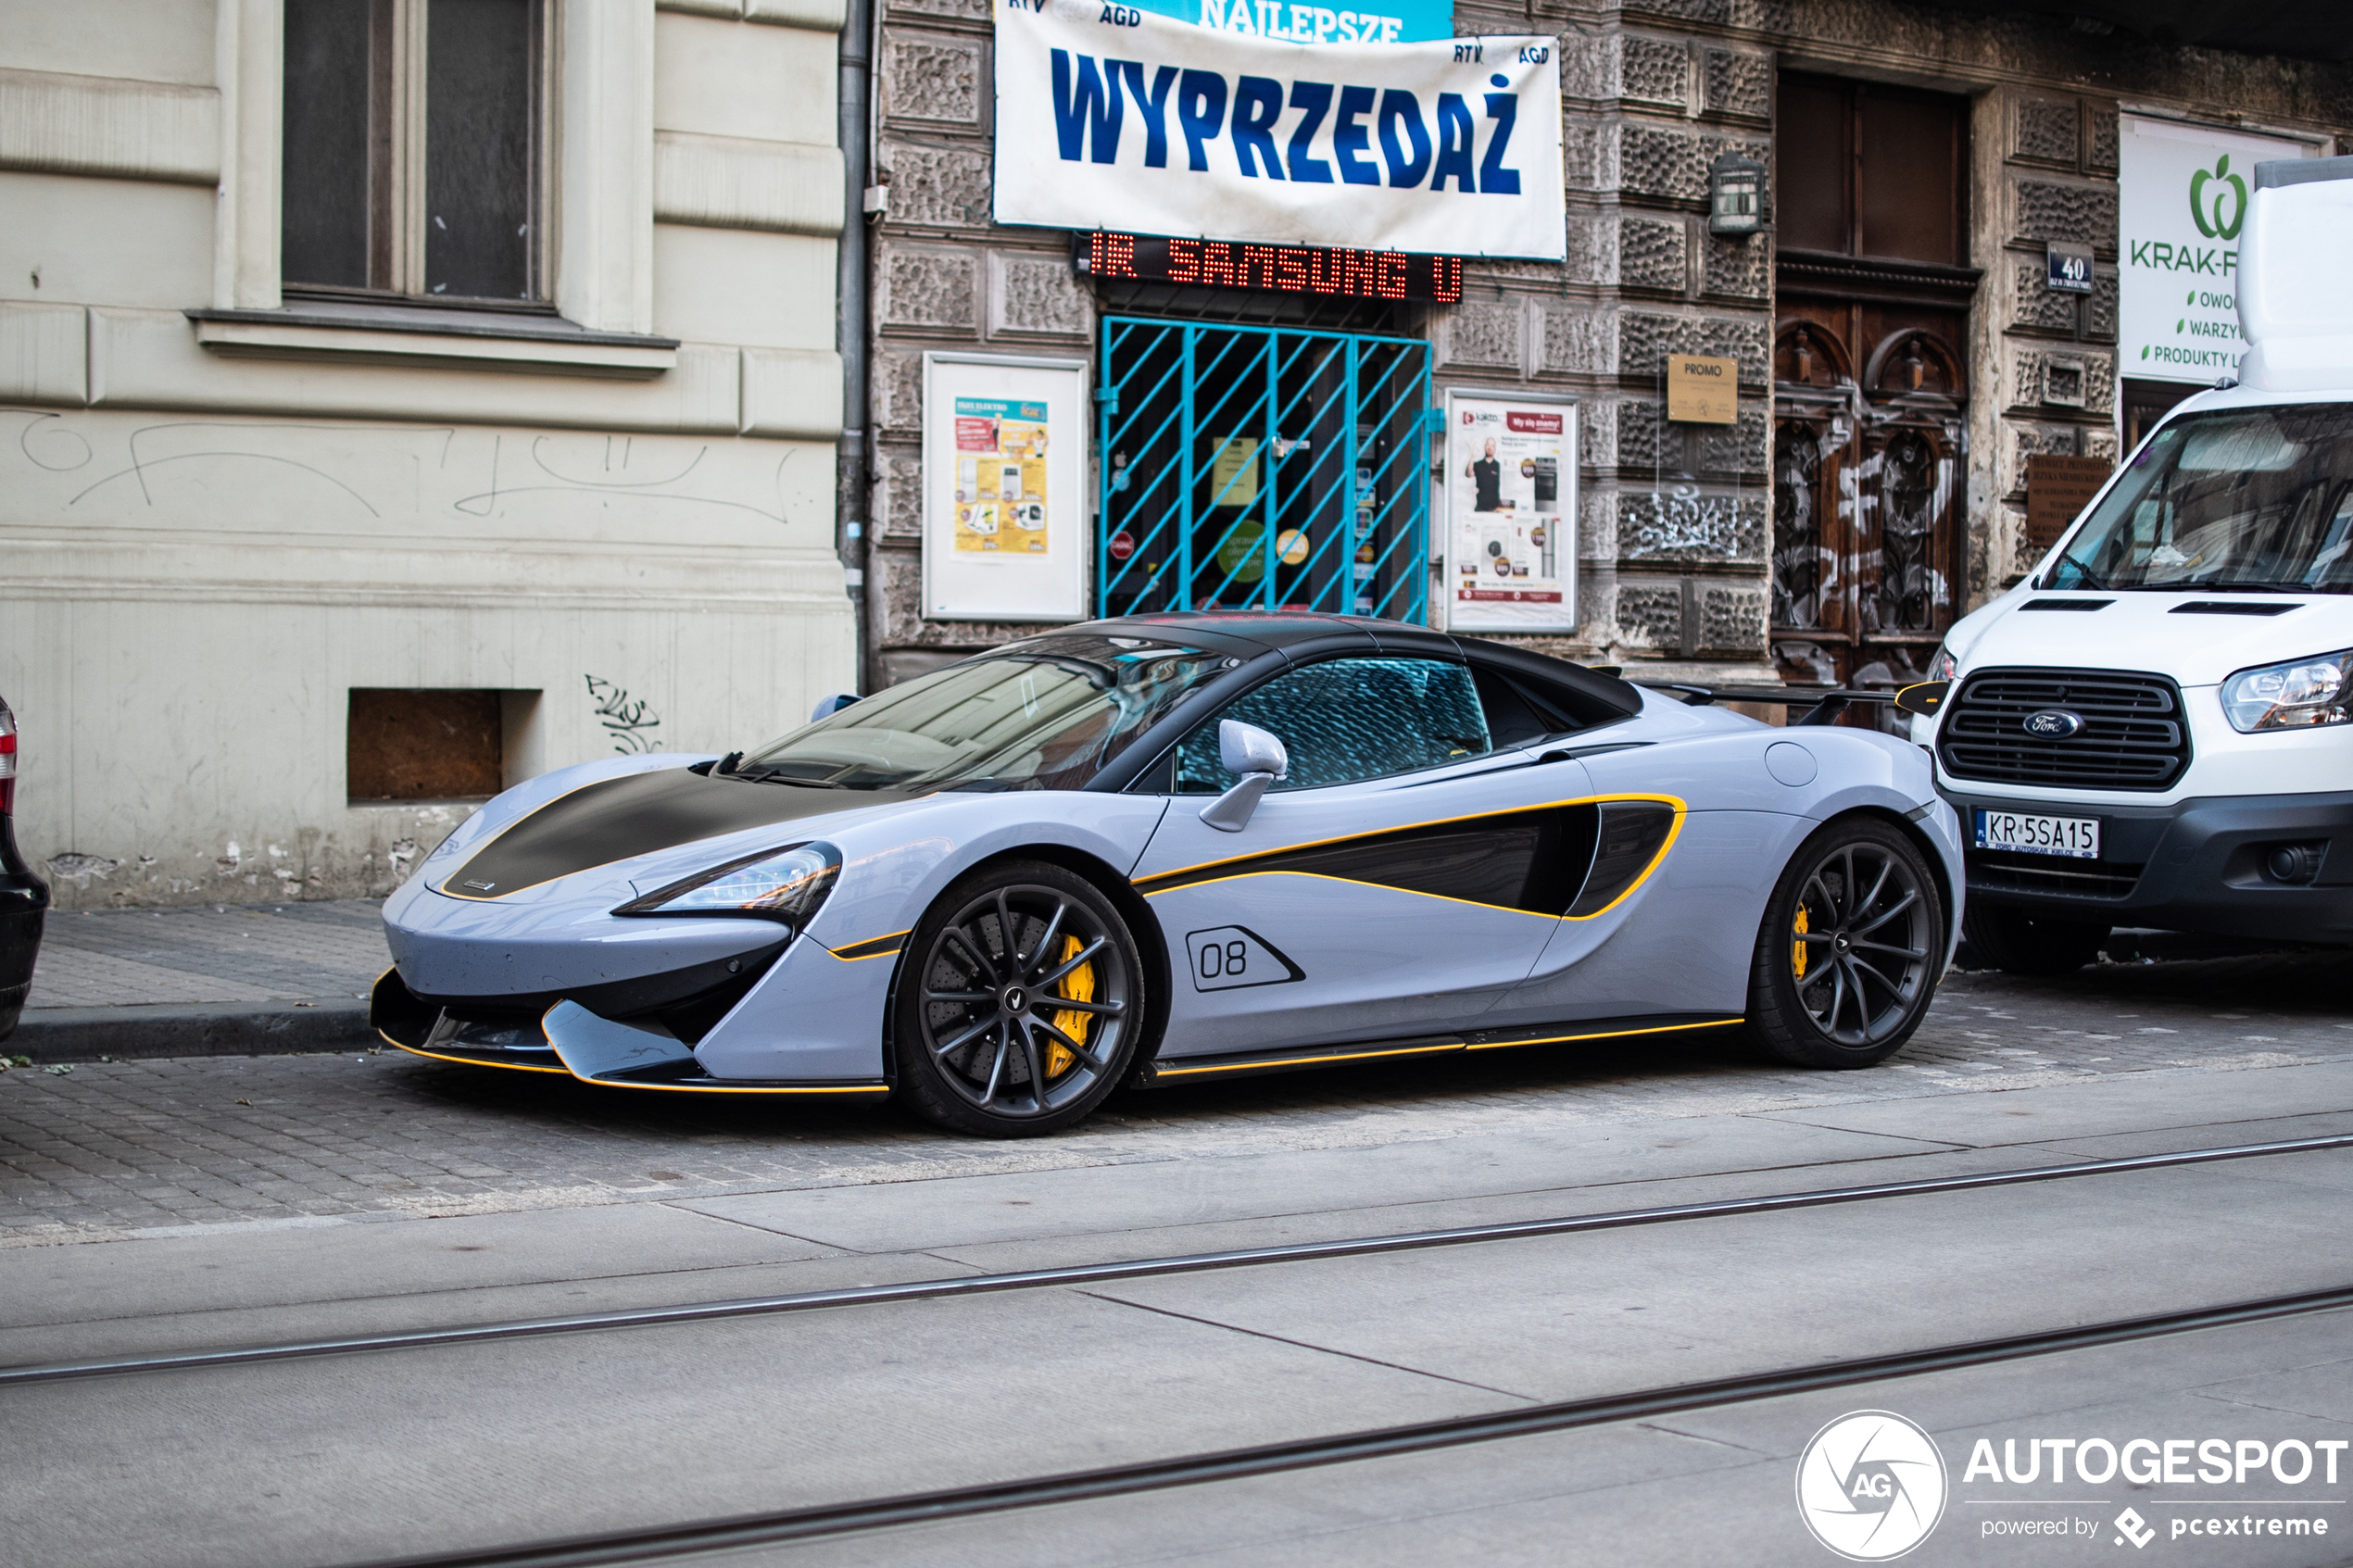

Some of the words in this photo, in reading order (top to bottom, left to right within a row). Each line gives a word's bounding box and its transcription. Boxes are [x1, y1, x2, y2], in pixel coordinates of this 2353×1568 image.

[1099, 5, 1140, 27] AGD
[1453, 44, 1483, 63] RTV
[1518, 46, 1549, 64] AGD
[1051, 47, 1521, 194] WYPRZEDAŻ
[1168, 238, 1407, 298] SAMSUNG
[2062, 257, 2084, 281] 40
[2155, 345, 2229, 368] PRODUKTY
[1684, 363, 1723, 377] PROMO
[2032, 715, 2063, 733] Ford
[1989, 814, 2017, 844] KR
[2025, 817, 2094, 849] 5SA15
[1201, 940, 1247, 979] 08
